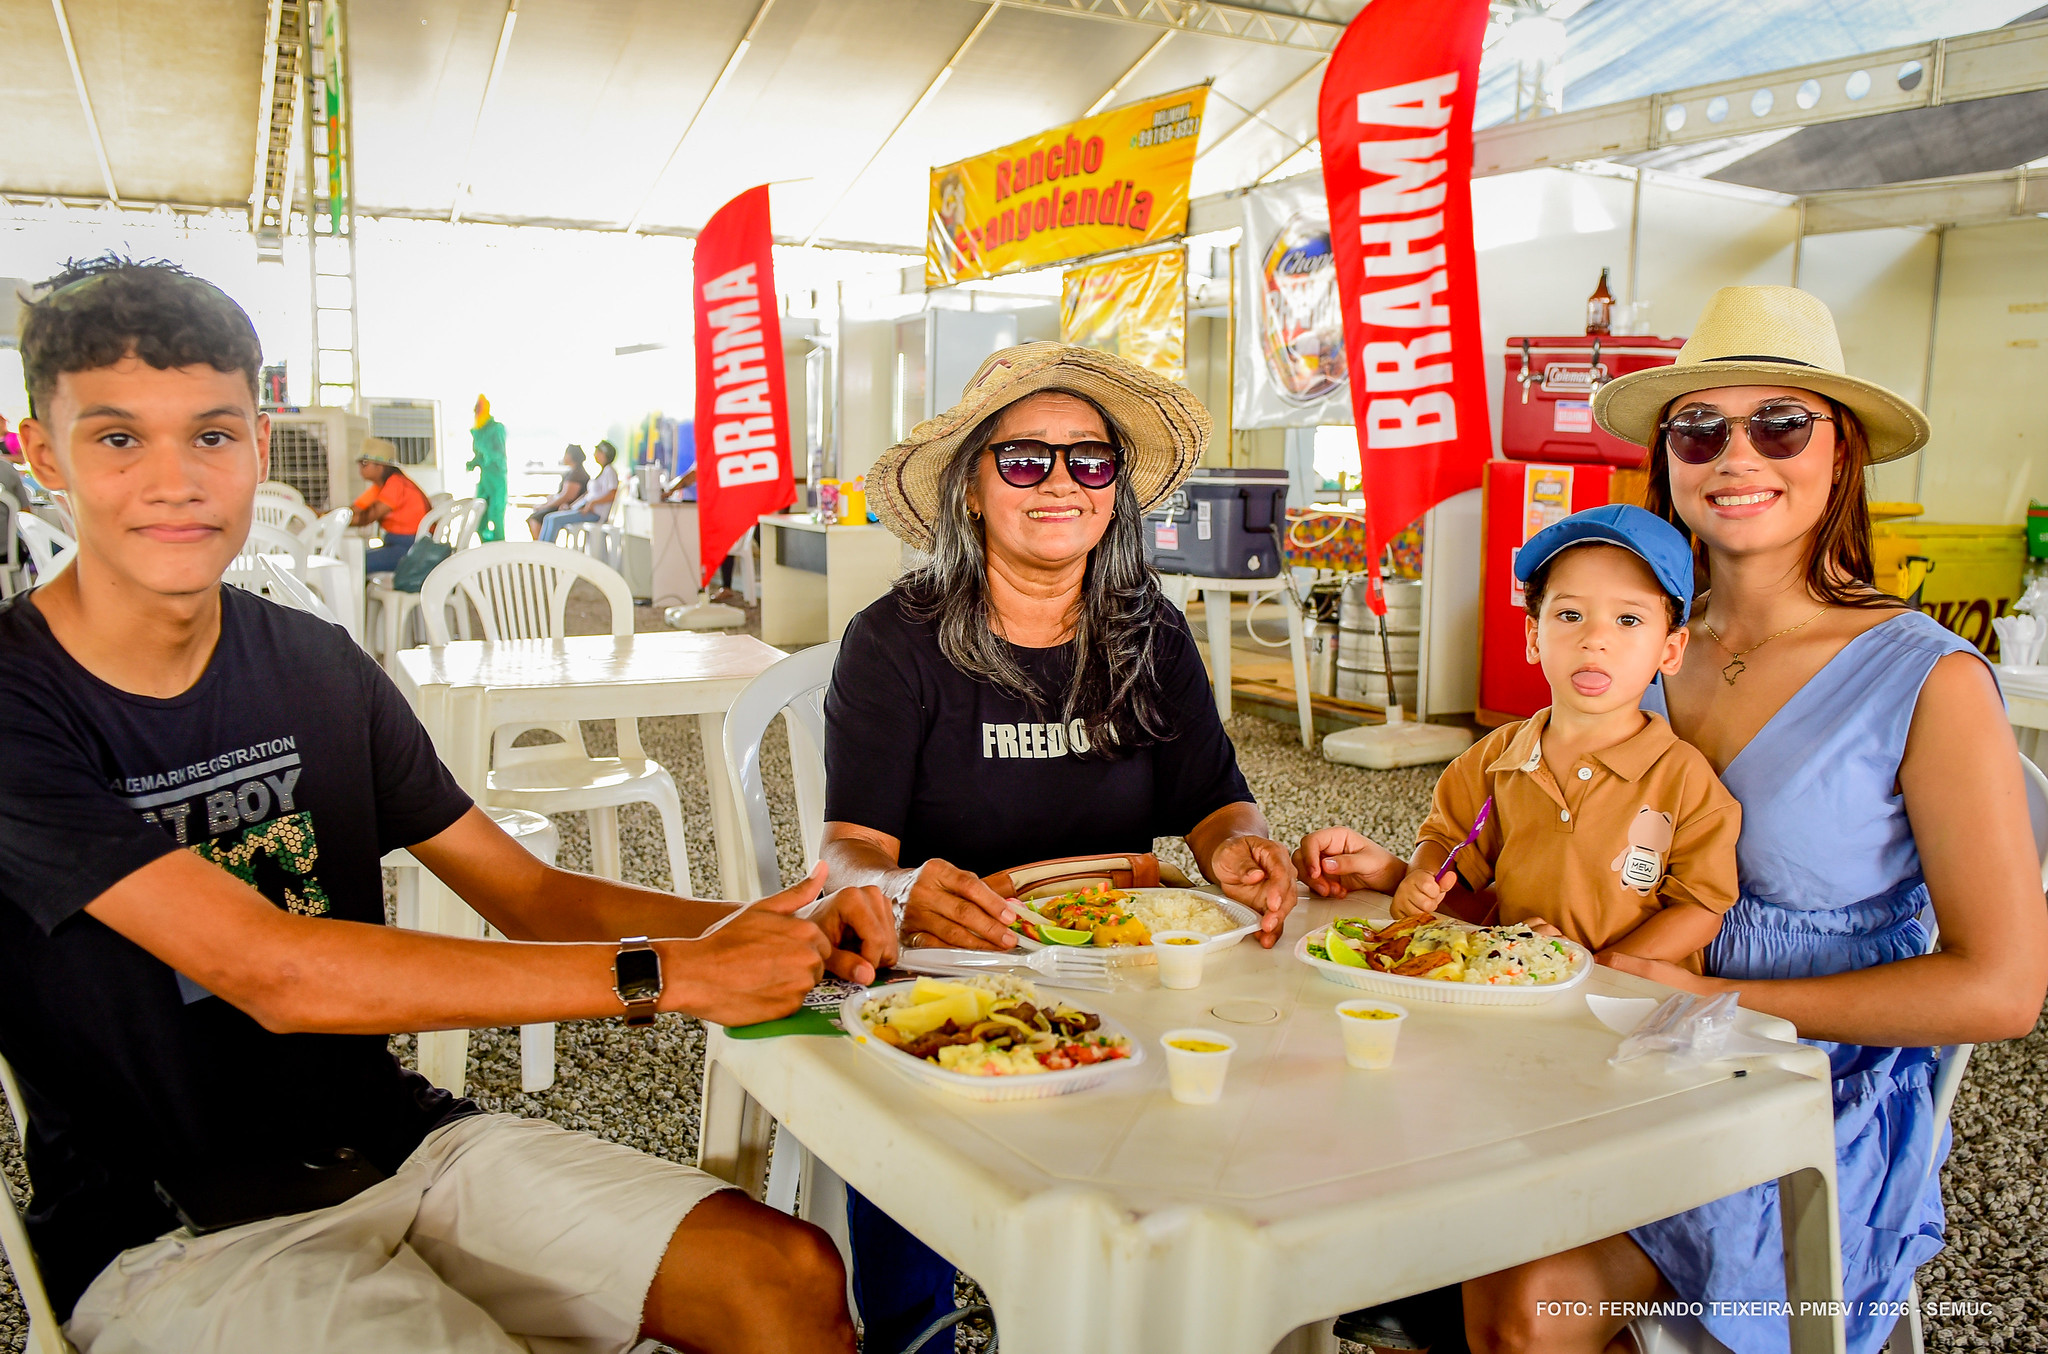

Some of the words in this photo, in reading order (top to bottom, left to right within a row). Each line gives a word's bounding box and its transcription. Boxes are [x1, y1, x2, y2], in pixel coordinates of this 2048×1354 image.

[996, 133, 1105, 203] Rancho
[955, 180, 1155, 273] Frangolandia
[1356, 71, 1460, 450] BRAHMA
[703, 262, 780, 488] BRAHMA
[1550, 367, 1593, 383] Colema
[982, 717, 1121, 759] FREEDO
[205, 768, 302, 835] BOY
